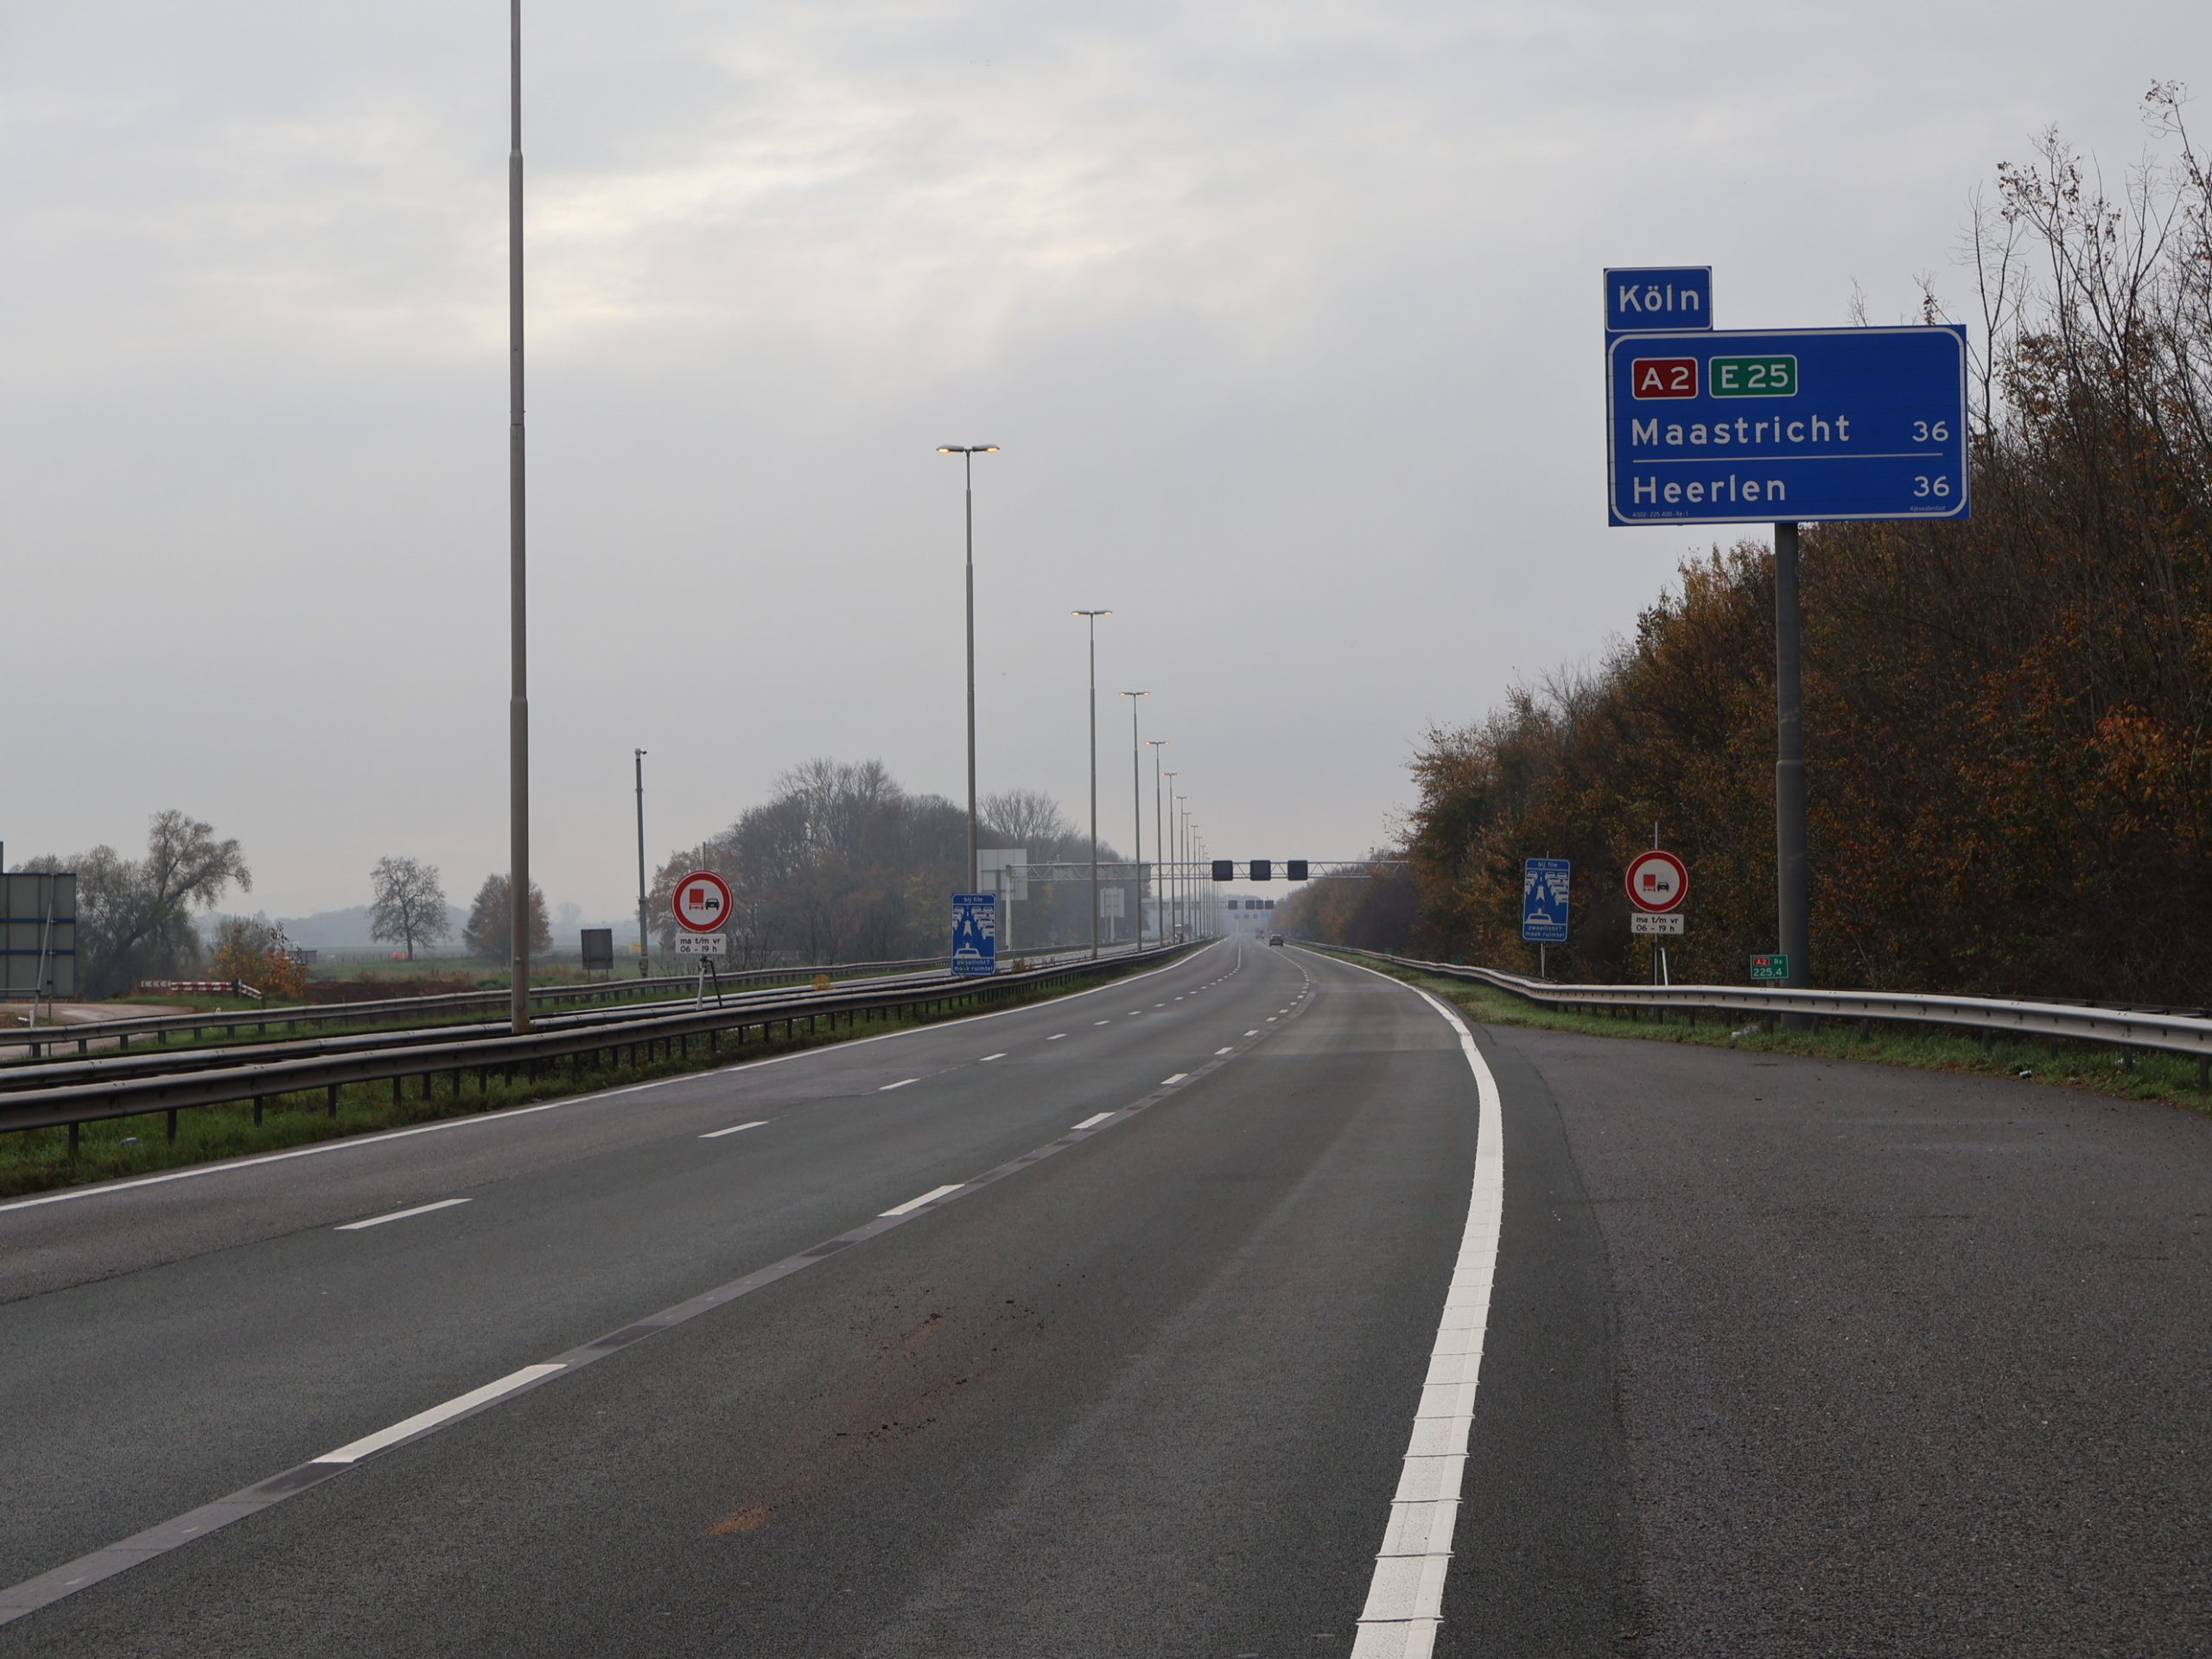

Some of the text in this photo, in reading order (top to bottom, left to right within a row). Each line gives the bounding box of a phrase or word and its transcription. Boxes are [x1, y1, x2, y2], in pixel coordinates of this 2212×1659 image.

[1619, 283, 1700, 313] Köln
[1641, 366, 1689, 391] A2
[1720, 364, 1789, 389] E25
[1631, 414, 1949, 446] Maastricht 36
[1633, 474, 1950, 504] Heerlen 36
[1753, 968, 1782, 976] 225.4
